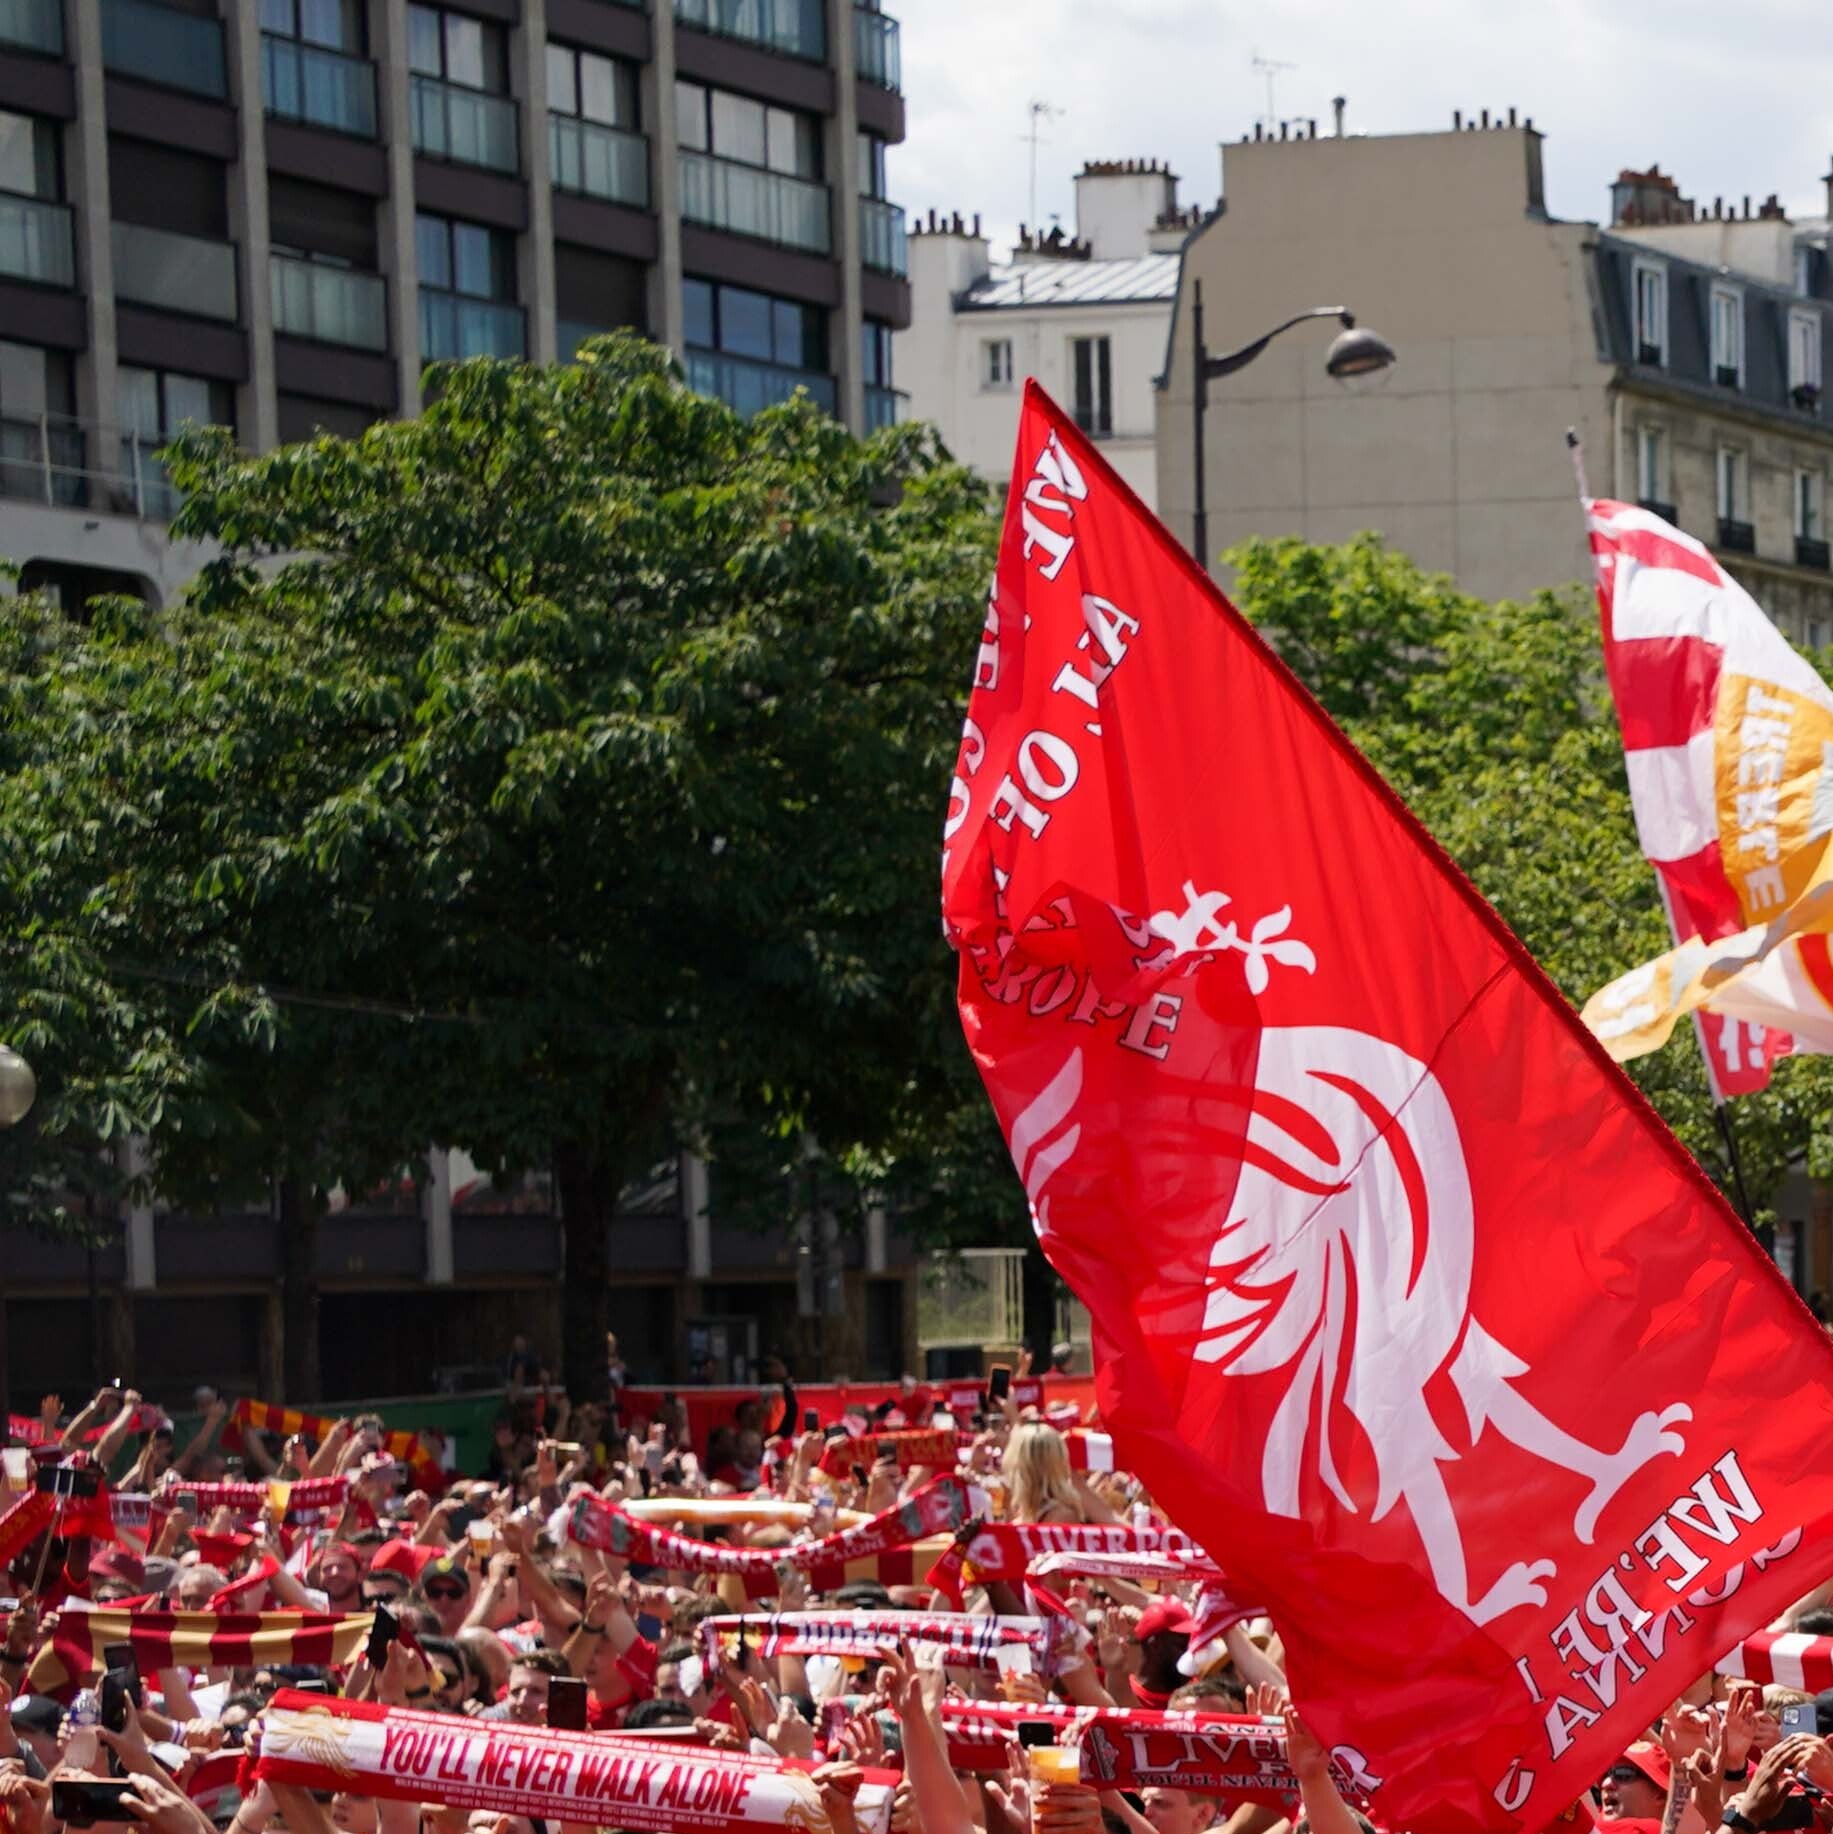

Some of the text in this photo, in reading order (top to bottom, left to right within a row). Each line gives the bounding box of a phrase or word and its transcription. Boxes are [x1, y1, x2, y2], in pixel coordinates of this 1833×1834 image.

[379, 1725, 760, 1818] YOU'LL NEVER WALK ALONE
[1220, 1774, 1299, 1790] NEVER
